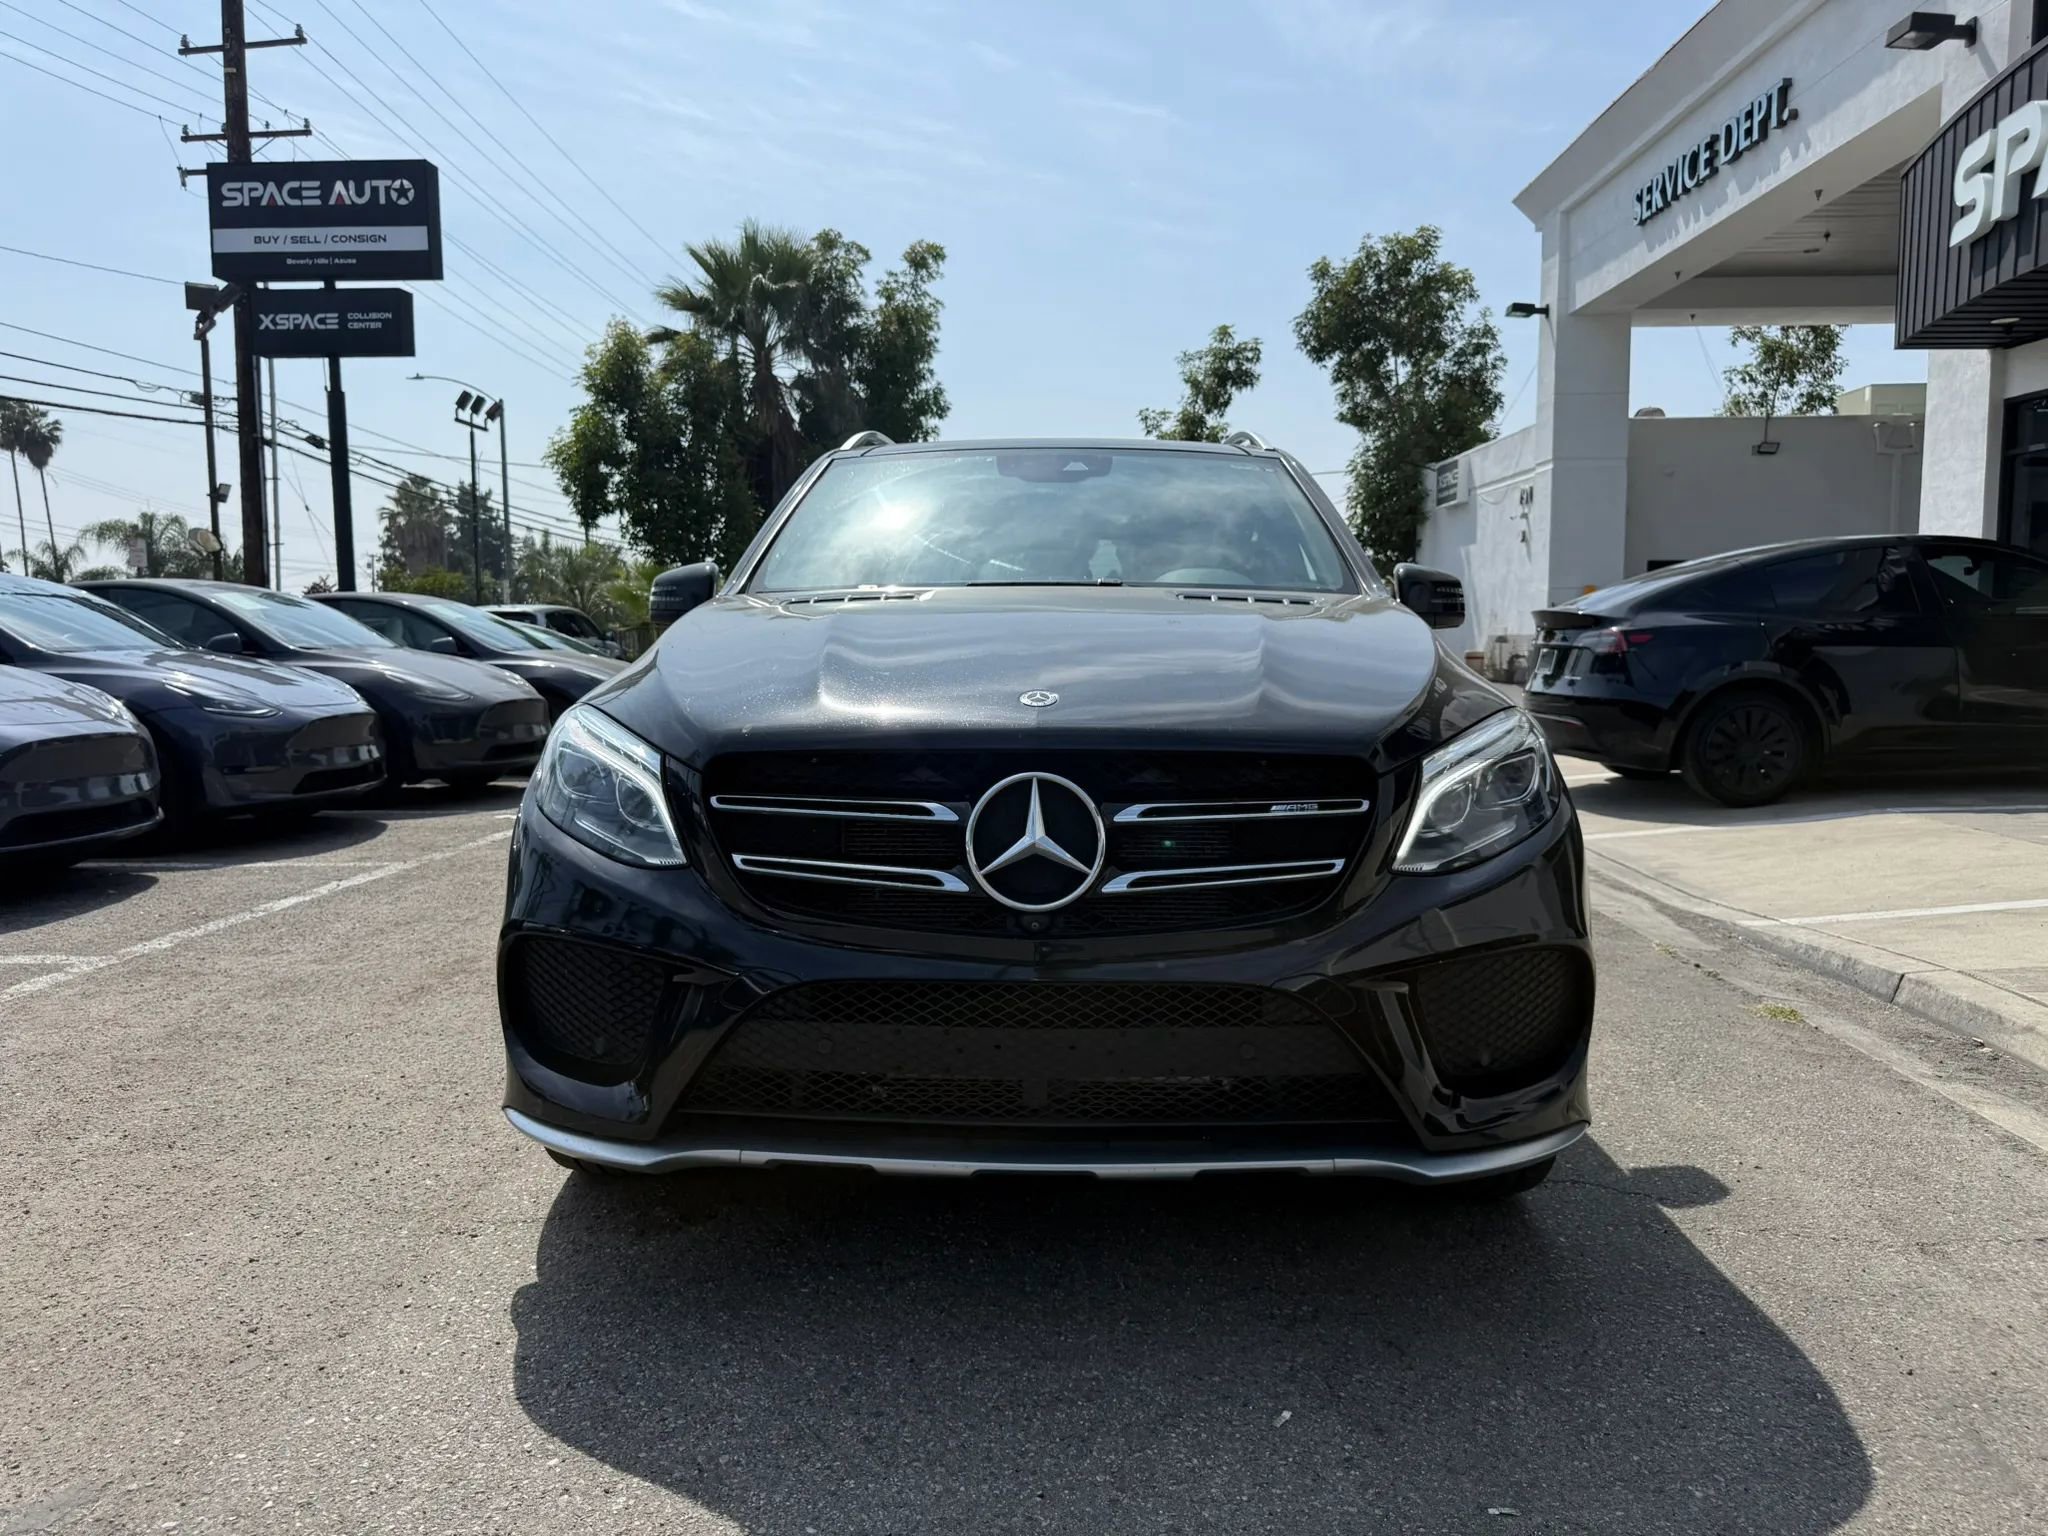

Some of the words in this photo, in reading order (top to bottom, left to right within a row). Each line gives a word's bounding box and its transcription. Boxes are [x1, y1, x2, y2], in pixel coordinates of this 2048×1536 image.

[1633, 134, 1720, 226] SERVICE
[1719, 77, 1799, 166] DEPT.
[1949, 99, 2048, 248] SP
[221, 181, 322, 207] SPACE
[253, 235, 280, 245] BUY
[290, 235, 322, 245] SELL
[330, 233, 387, 244] CONSIGN
[286, 257, 313, 266] Beverly
[314, 257, 329, 265] Hills
[258, 312, 340, 330] XSPACE
[347, 311, 393, 320] COLLISION
[347, 321, 382, 329] CENTER
